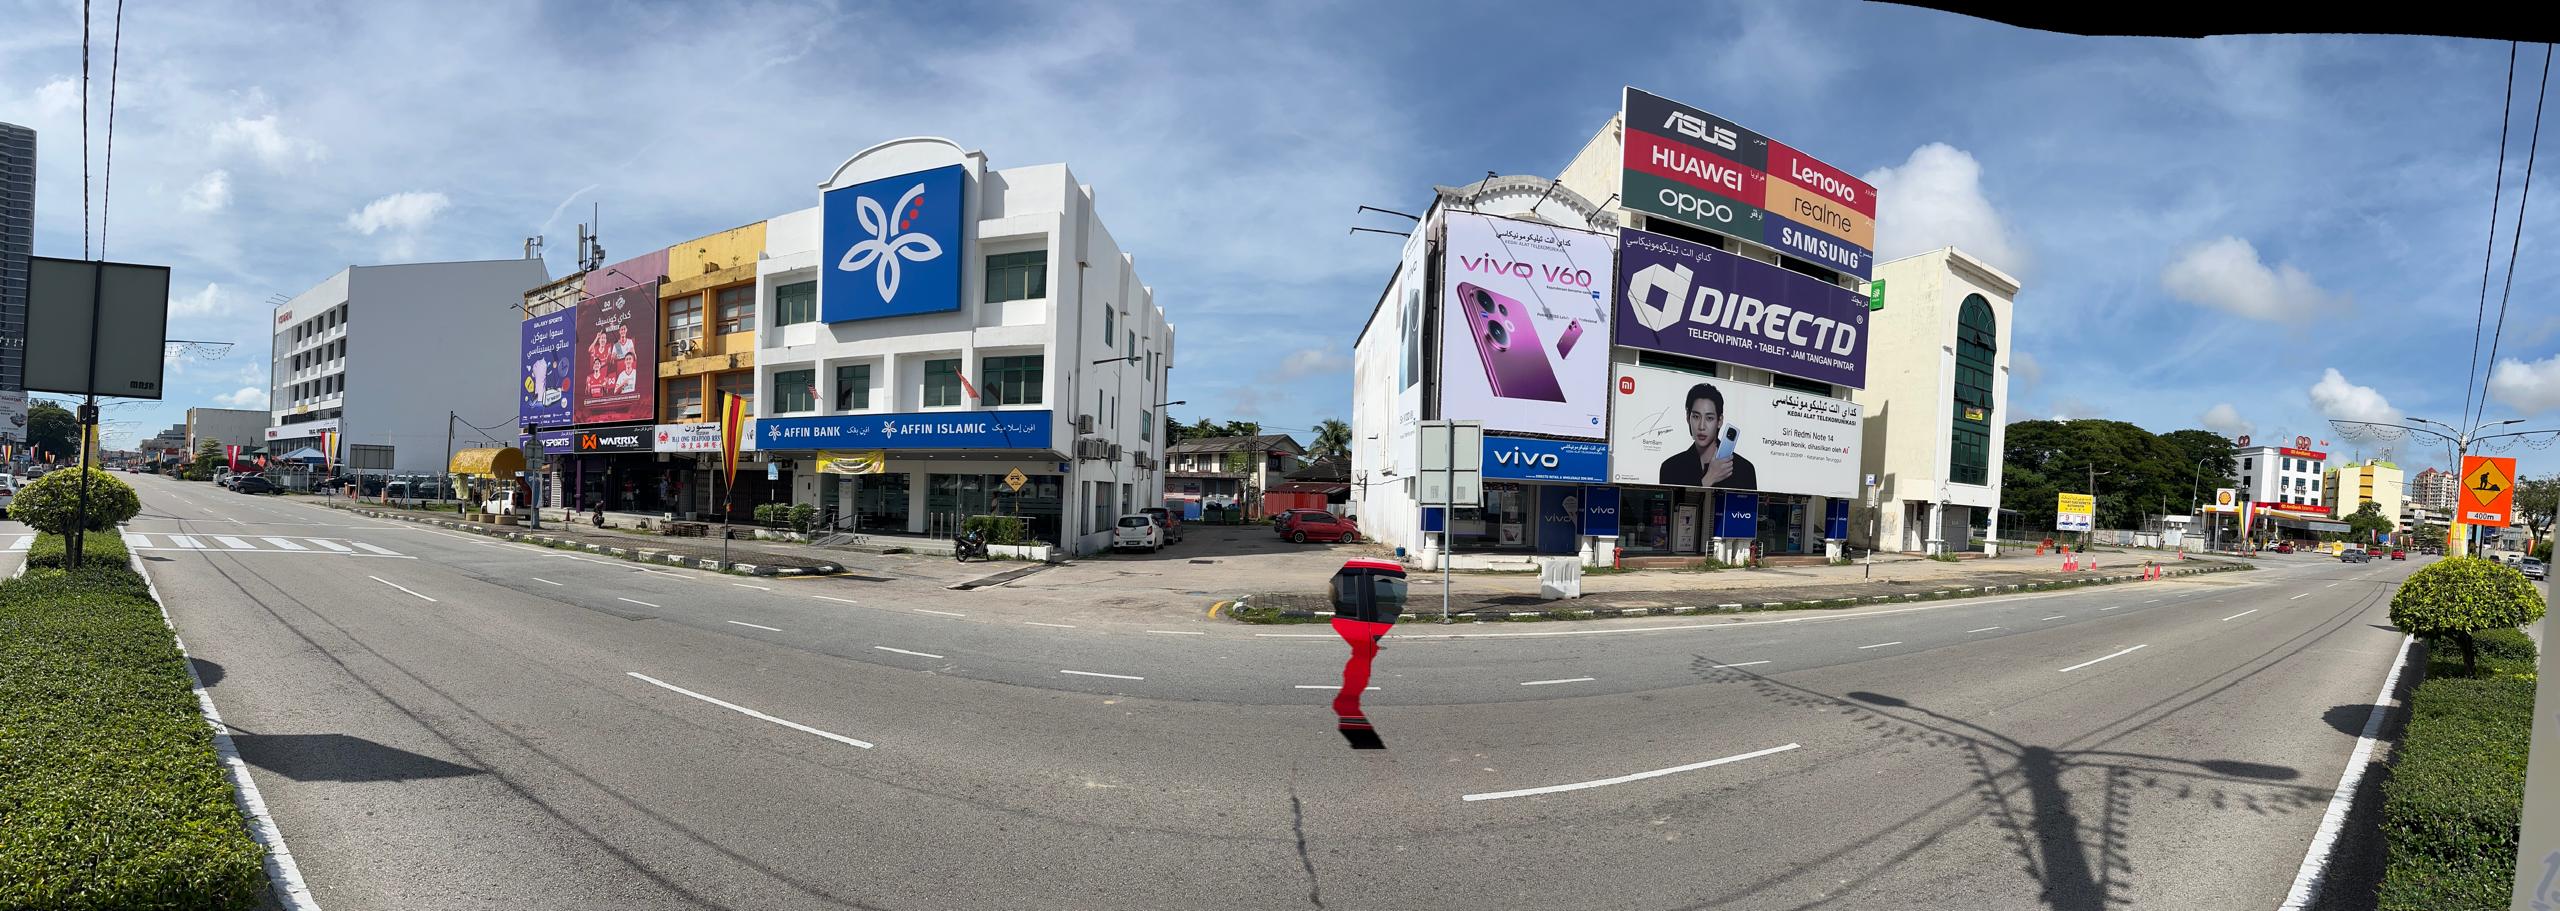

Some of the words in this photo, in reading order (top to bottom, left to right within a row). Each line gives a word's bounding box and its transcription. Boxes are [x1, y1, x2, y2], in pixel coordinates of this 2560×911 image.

[1663, 111, 1737, 151] ASUS
[1652, 145, 1742, 192] HUAWEI
[1792, 158, 1855, 202] Lenovo
[1659, 188, 1733, 223] oppo
[1795, 197, 1851, 233] realme
[1695, 251, 1712, 263] كداي
[1782, 227, 1859, 269] SAMSUNG
[1460, 253, 1534, 279] vivo
[1541, 263, 1592, 288] V60
[1688, 286, 1857, 357] DIRECTD
[1688, 327, 1725, 344] TELEFON
[1725, 336, 1753, 350] PINTAR
[1758, 342, 1786, 356] TABLET
[1790, 348, 1806, 360] JAM
[1806, 352, 1833, 367] TANGAN
[1832, 357, 1855, 372] PINTAR
[1787, 410, 1803, 418] KEDAI
[1803, 412, 1816, 420] ALAT
[784, 427, 810, 438] AFFIN
[814, 426, 840, 437] BANK
[900, 424, 933, 435] AFFIN
[937, 423, 986, 435] ISLAMIC
[1782, 428, 1793, 436] Siri
[1793, 429, 1812, 439] Redmi
[1812, 431, 1827, 441] Note
[1827, 434, 1834, 442] 14
[545, 438, 570, 447] SPORTS
[599, 436, 639, 446] WARRIX
[1762, 437, 1790, 448] Tangkapan
[1807, 442, 1832, 452] dihasilkan
[1494, 446, 1559, 468] vivo
[1590, 505, 1615, 515] vivo
[1731, 511, 1752, 519] vivo
